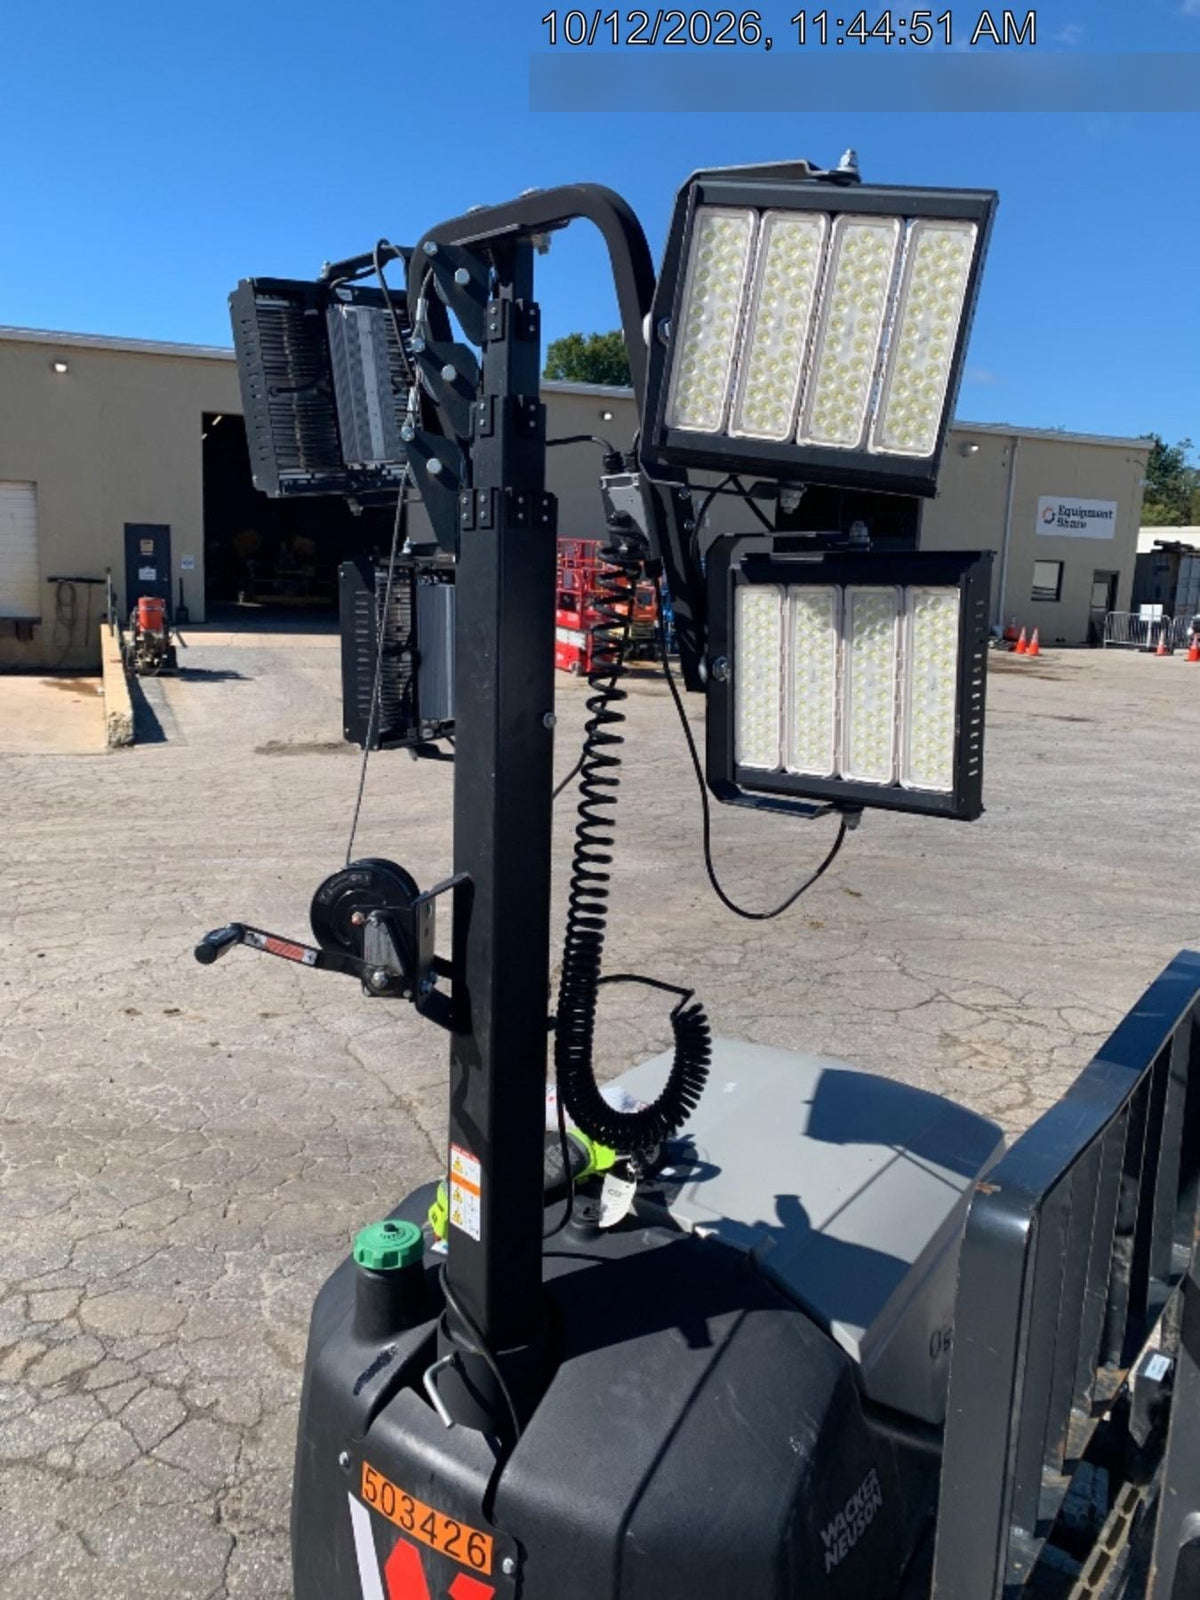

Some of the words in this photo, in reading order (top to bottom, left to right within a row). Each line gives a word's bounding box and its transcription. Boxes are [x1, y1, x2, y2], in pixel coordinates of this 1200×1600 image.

[1056, 517, 1087, 528] Share
[1058, 505, 1113, 519] Equipment
[365, 1468, 486, 1568] 503426
[820, 1468, 879, 1547] WACKER
[825, 1484, 882, 1574] NEUSON
